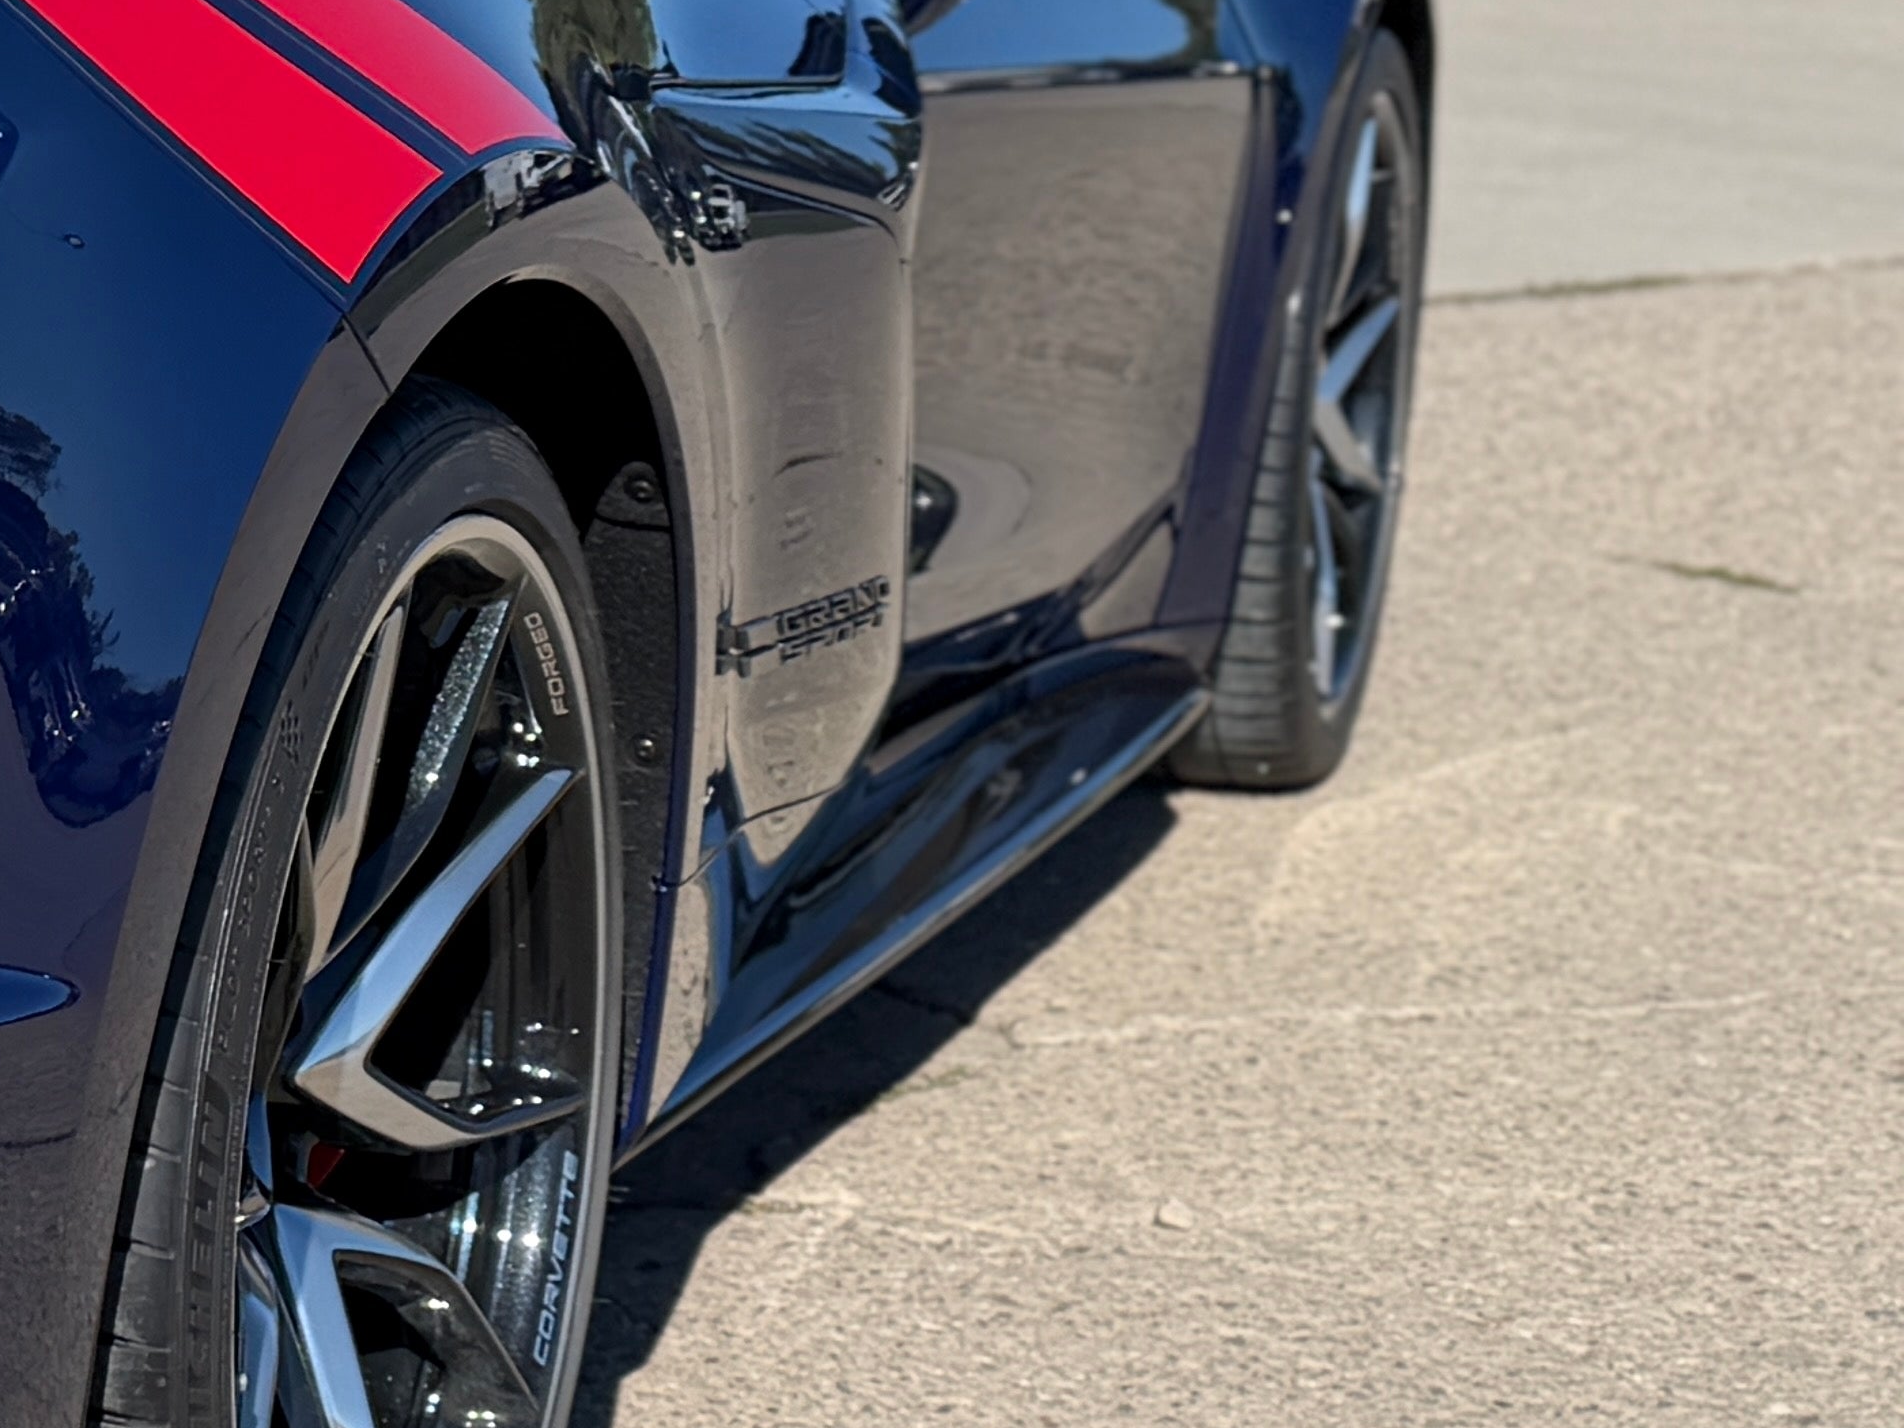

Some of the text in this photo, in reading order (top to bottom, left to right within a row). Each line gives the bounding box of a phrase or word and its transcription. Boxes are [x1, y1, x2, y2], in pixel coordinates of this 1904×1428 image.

[776, 574, 890, 642] GRAND
[523, 611, 570, 716] FORGED
[533, 1149, 579, 1367] CORVETTE
